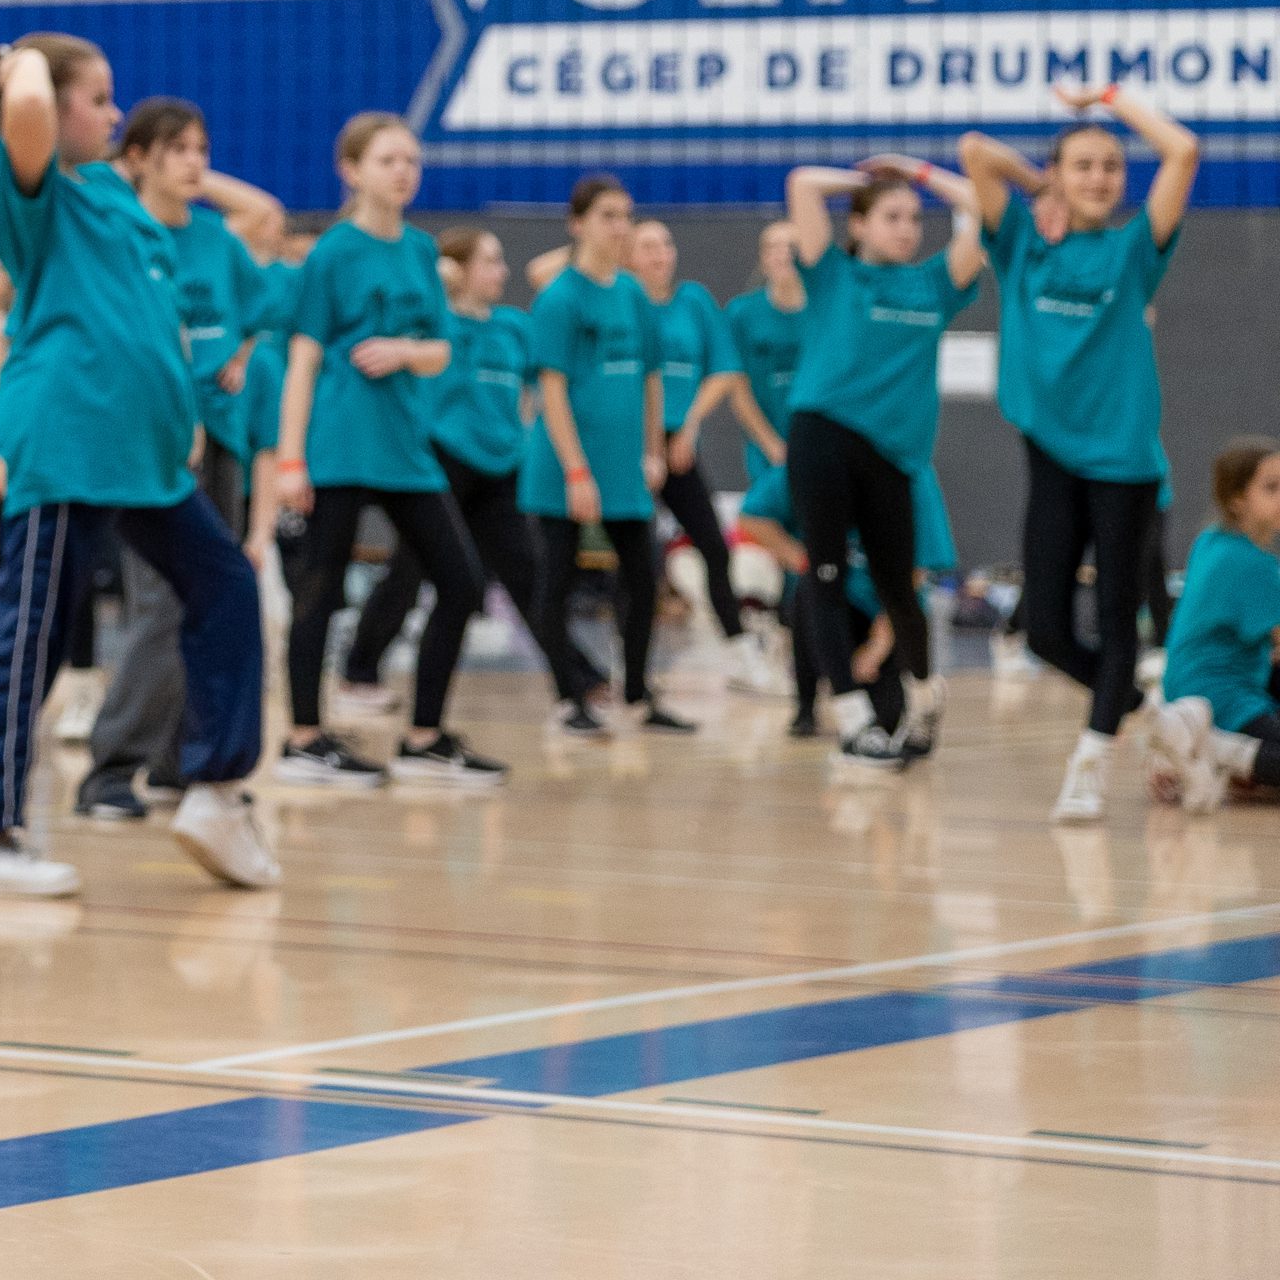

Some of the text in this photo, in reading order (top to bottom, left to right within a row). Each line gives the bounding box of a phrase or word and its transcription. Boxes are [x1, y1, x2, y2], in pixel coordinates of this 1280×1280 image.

[505, 40, 1269, 96] CÉGEP DE DRUMMON
